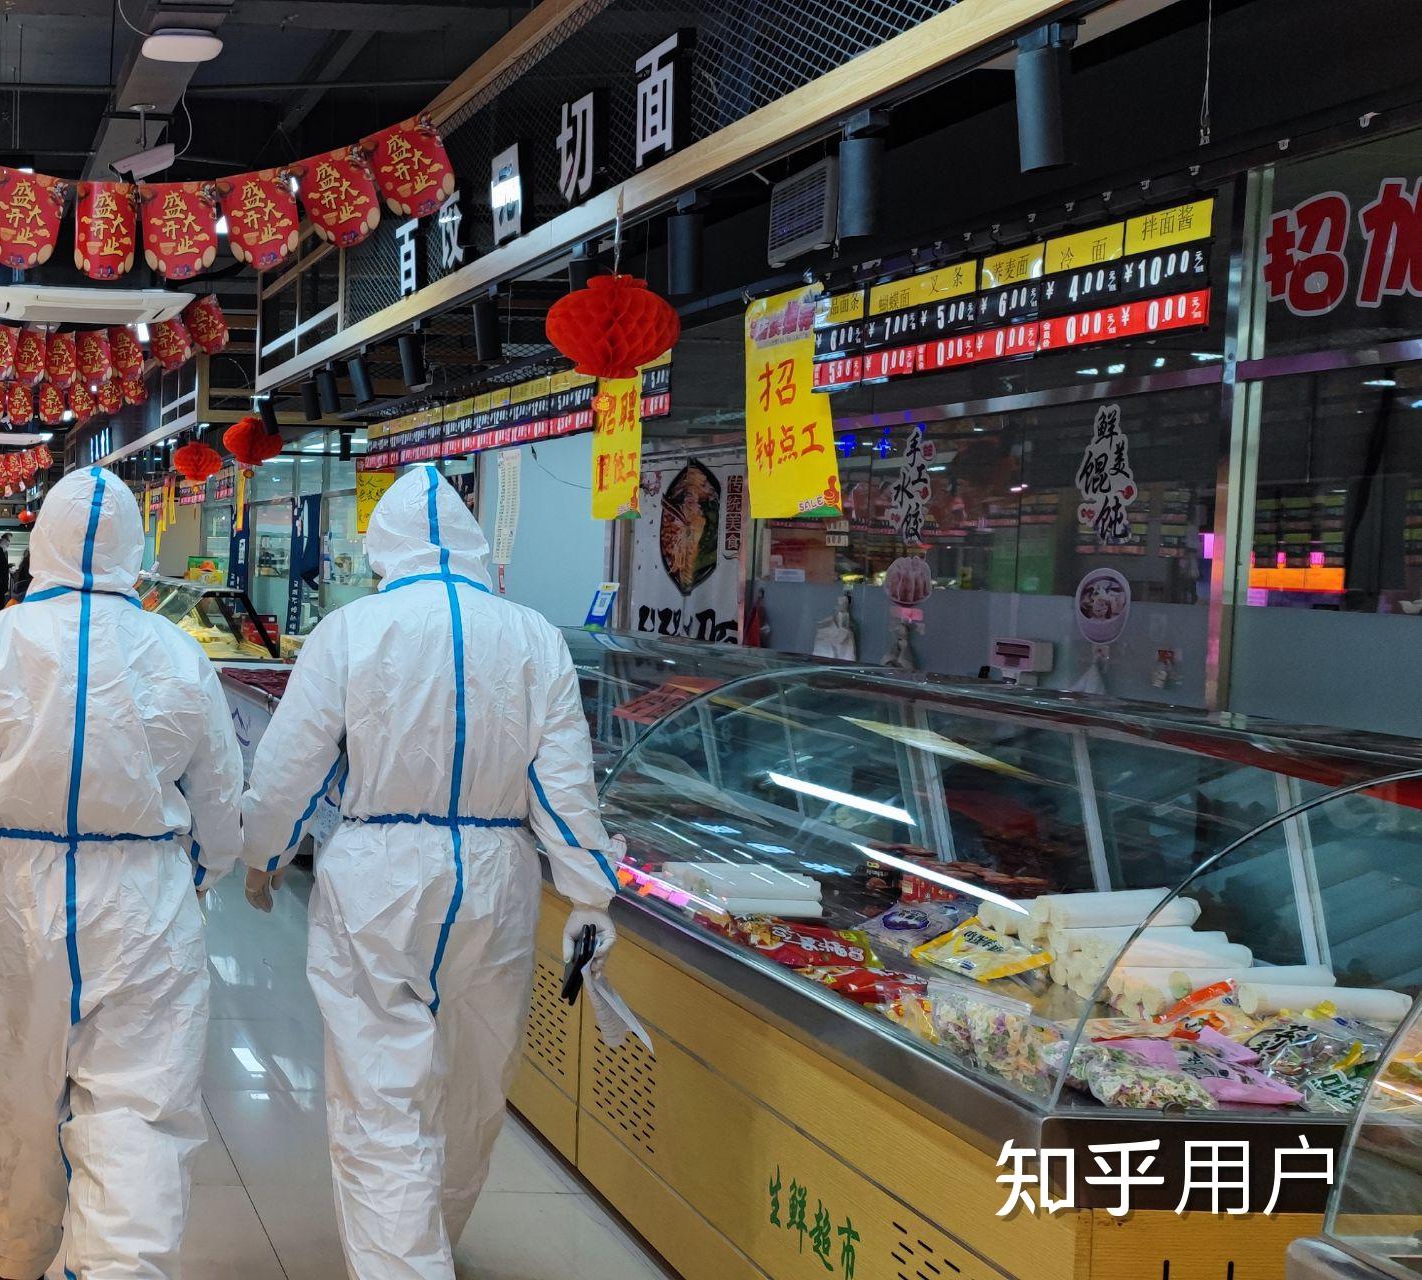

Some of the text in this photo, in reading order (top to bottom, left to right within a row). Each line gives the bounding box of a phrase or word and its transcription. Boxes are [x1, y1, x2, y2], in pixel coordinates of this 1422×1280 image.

[758, 358, 797, 412] 招
[755, 422, 825, 476] 钟点工
[769, 1164, 861, 1280] 生鲜超市
